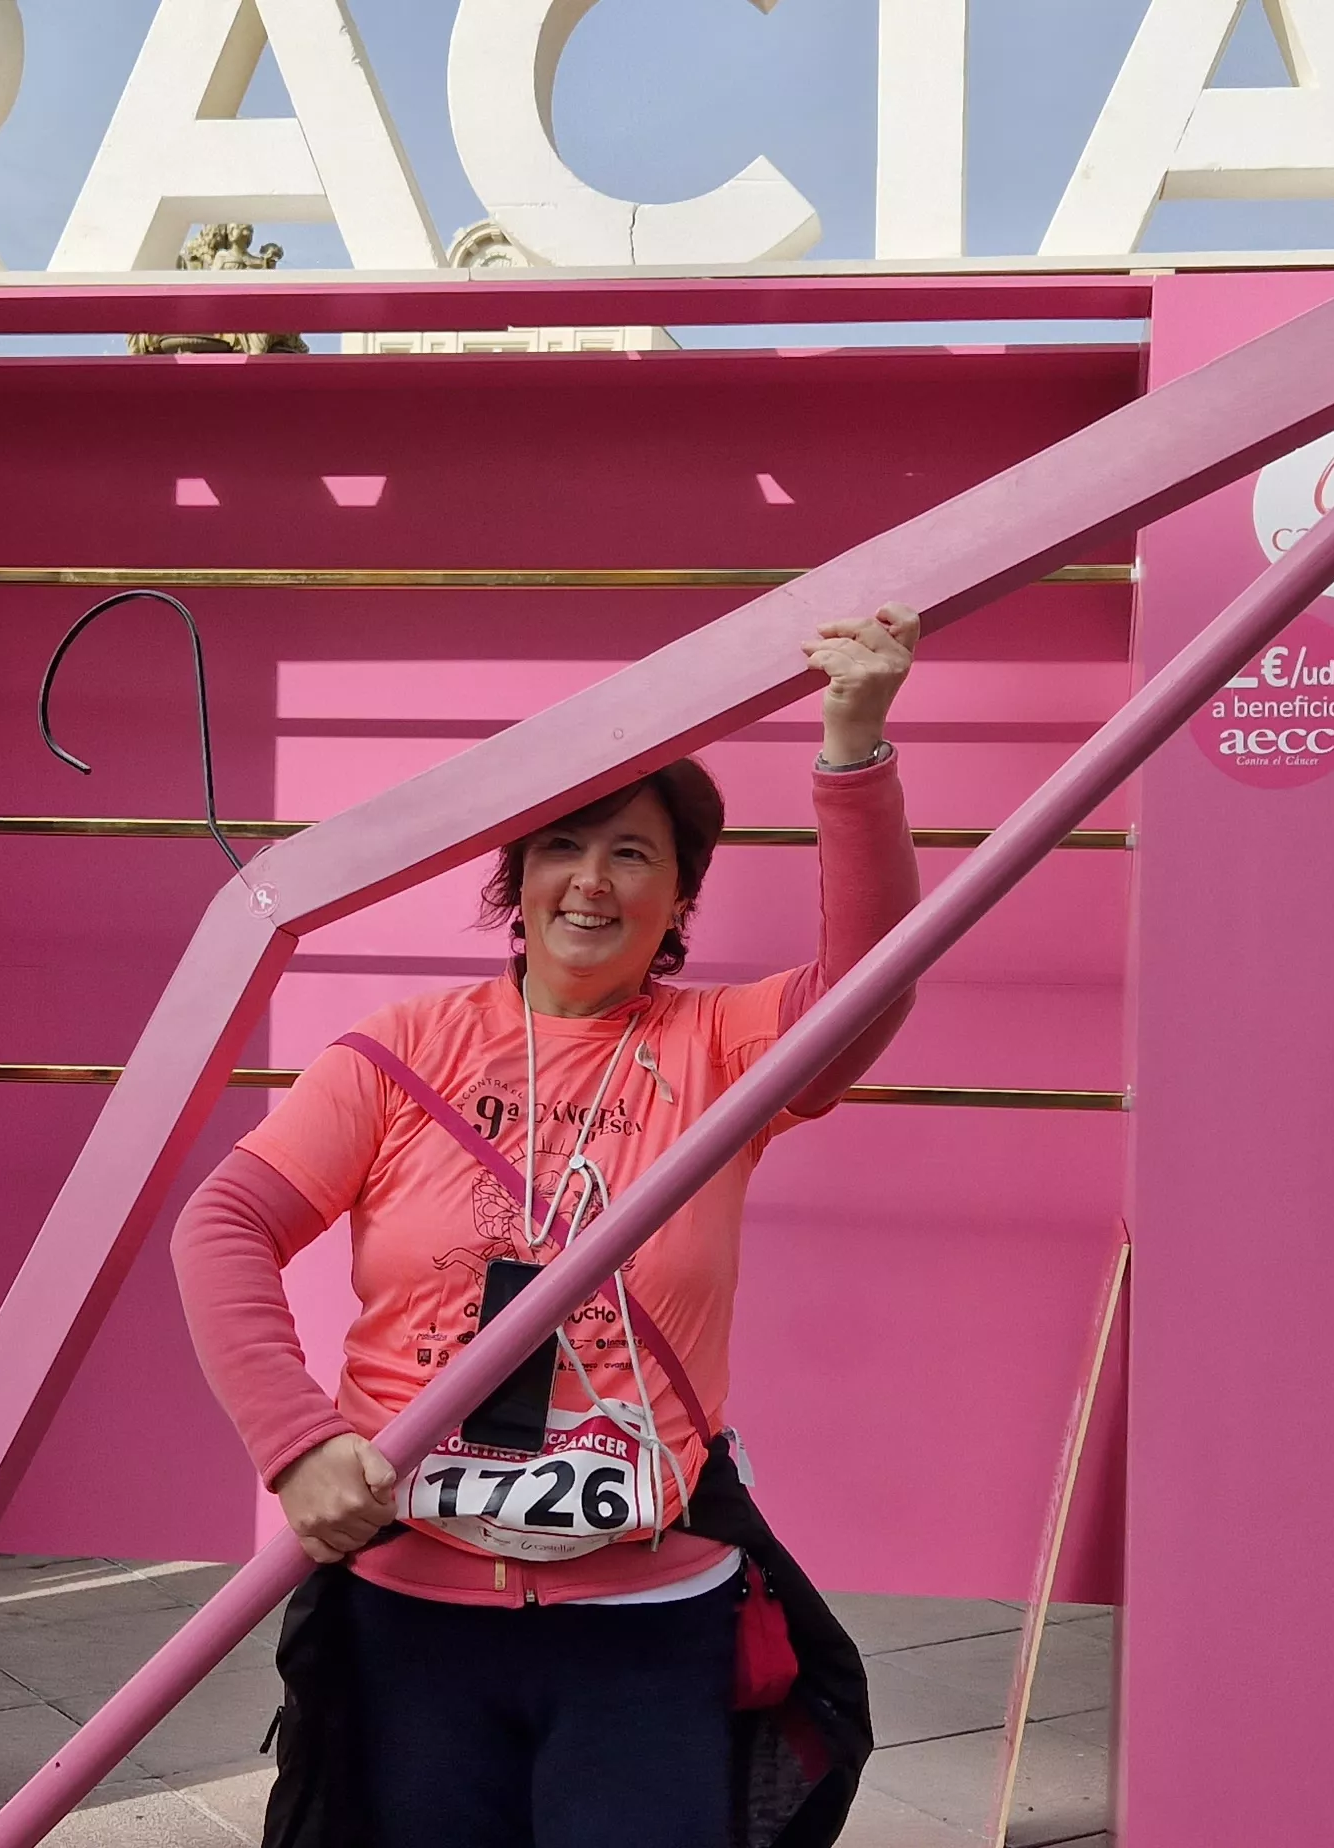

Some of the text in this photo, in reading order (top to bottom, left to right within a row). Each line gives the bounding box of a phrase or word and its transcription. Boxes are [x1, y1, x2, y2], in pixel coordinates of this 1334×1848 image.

[1211, 700, 1226, 718] a
[1236, 756, 1269, 766] Contra
[1272, 756, 1281, 766] el
[462, 1078, 508, 1100] CONTRA
[567, 1305, 616, 1324] UCHO
[424, 1460, 629, 1530] 1726
